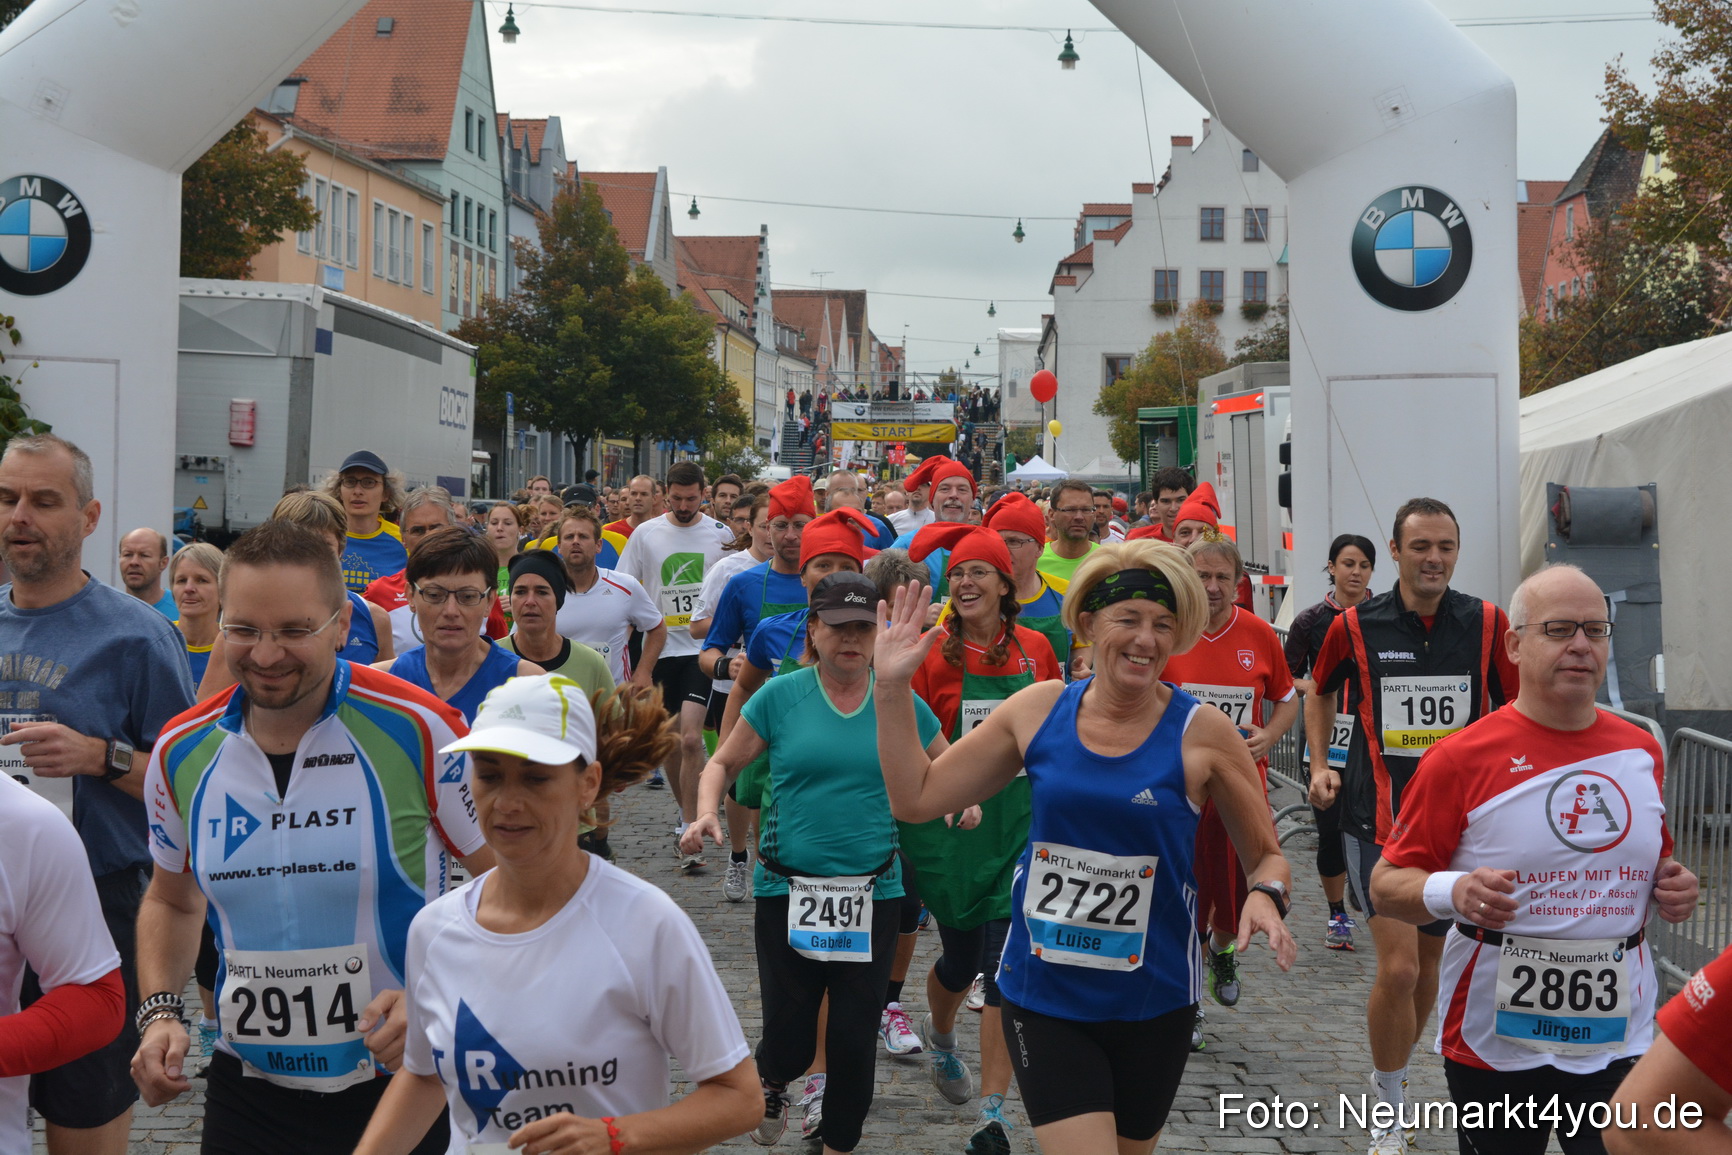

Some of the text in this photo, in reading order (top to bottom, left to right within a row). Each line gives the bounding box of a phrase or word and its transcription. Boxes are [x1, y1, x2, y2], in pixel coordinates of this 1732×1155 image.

[1361, 188, 1464, 231] BMW
[439, 386, 469, 430] BOCK
[872, 426, 915, 437] START
[1378, 650, 1417, 660] WÖHRL
[1208, 691, 1243, 699] Neumarkt
[1383, 684, 1457, 693] PARTL Neumarkt
[1401, 696, 1455, 726] 196
[1510, 764, 1533, 773] erima
[1131, 797, 1158, 806] adidas
[271, 807, 357, 831] PLAST
[209, 860, 357, 882] www.tr-plast.de
[1077, 862, 1136, 879] Neumarkt
[791, 884, 820, 893] PARTL
[1530, 890, 1547, 900] Dr.
[1550, 889, 1579, 899] Heck
[1589, 889, 1606, 899] Dr.
[1036, 872, 1141, 926] 2722
[799, 895, 865, 928] 2491
[1529, 904, 1635, 918] Leistungsdiagnostik
[1056, 929, 1102, 951] Luise
[1503, 946, 1609, 963] PARTL Neumarkt
[228, 963, 339, 979] PARTL Neumarkt
[1510, 965, 1618, 1012] 2863
[231, 982, 359, 1038] 2914
[1532, 1019, 1591, 1041] Jürgen
[267, 1052, 329, 1073] Martin
